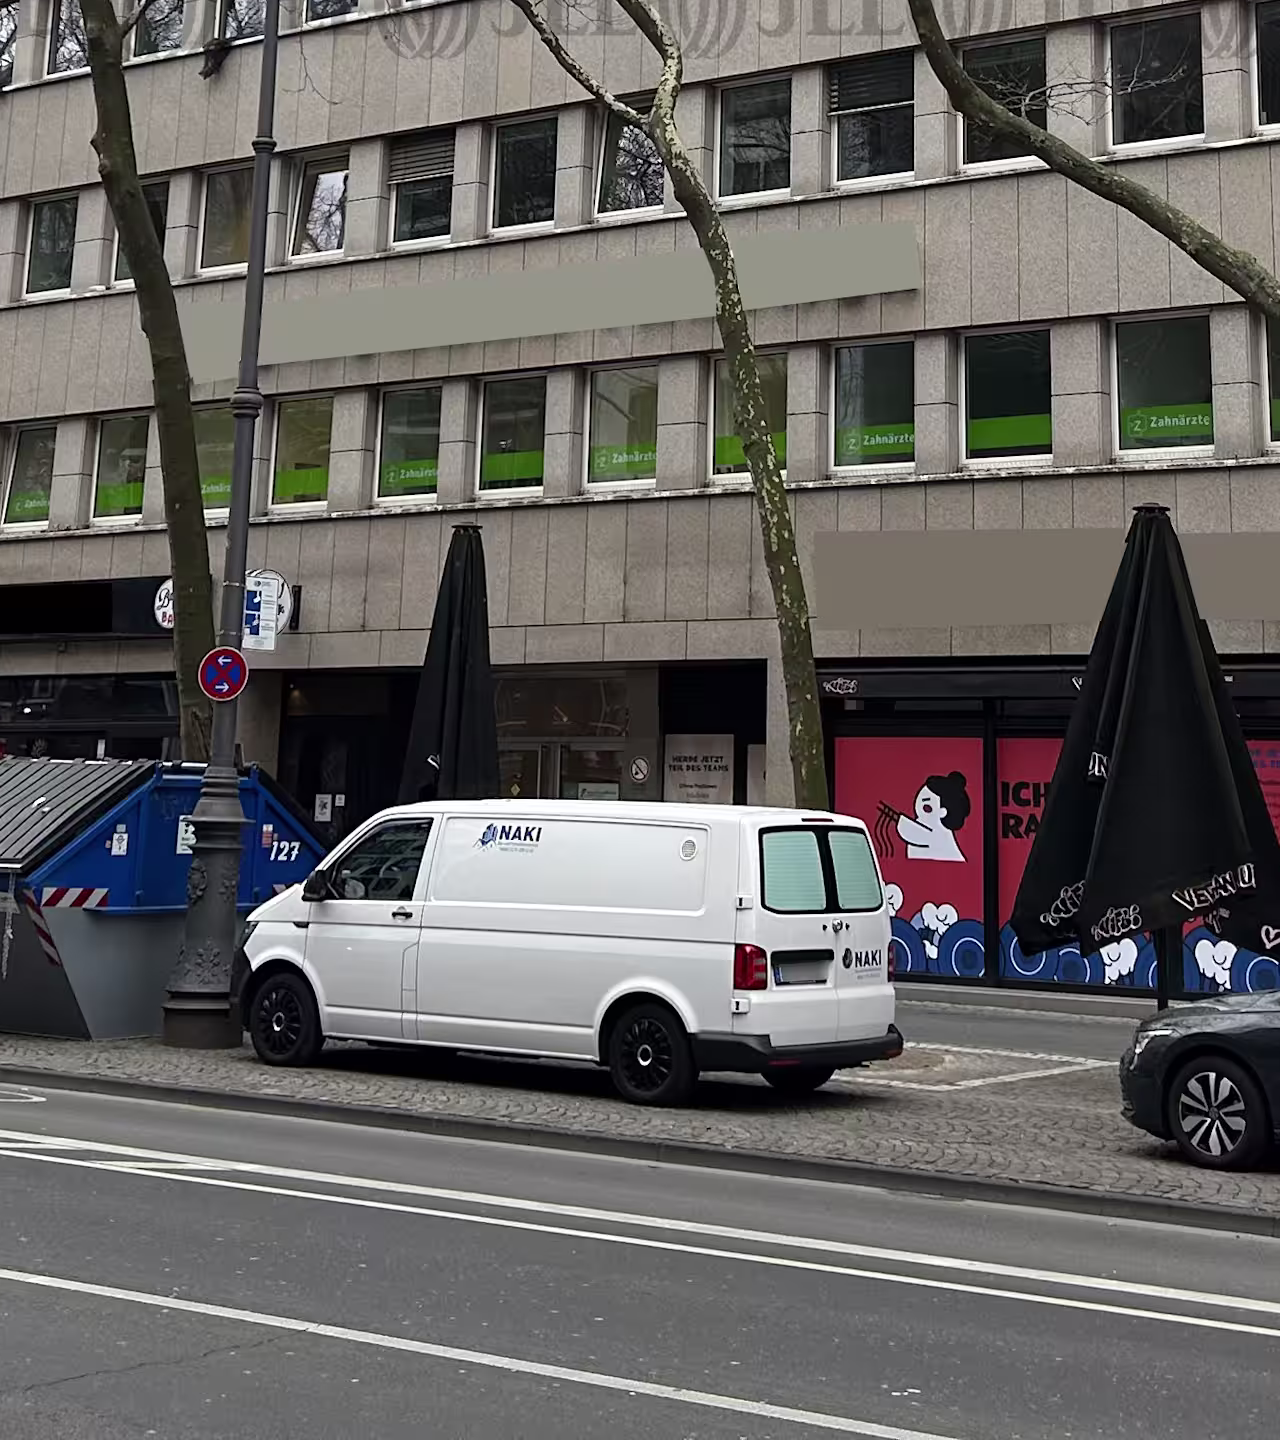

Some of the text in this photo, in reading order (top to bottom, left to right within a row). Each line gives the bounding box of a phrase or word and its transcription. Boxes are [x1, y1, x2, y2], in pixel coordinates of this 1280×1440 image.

[1150, 414, 1210, 428] Zahnärzte
[499, 825, 543, 842] NAKI
[270, 840, 301, 861] 127
[855, 949, 882, 968] NAKI
